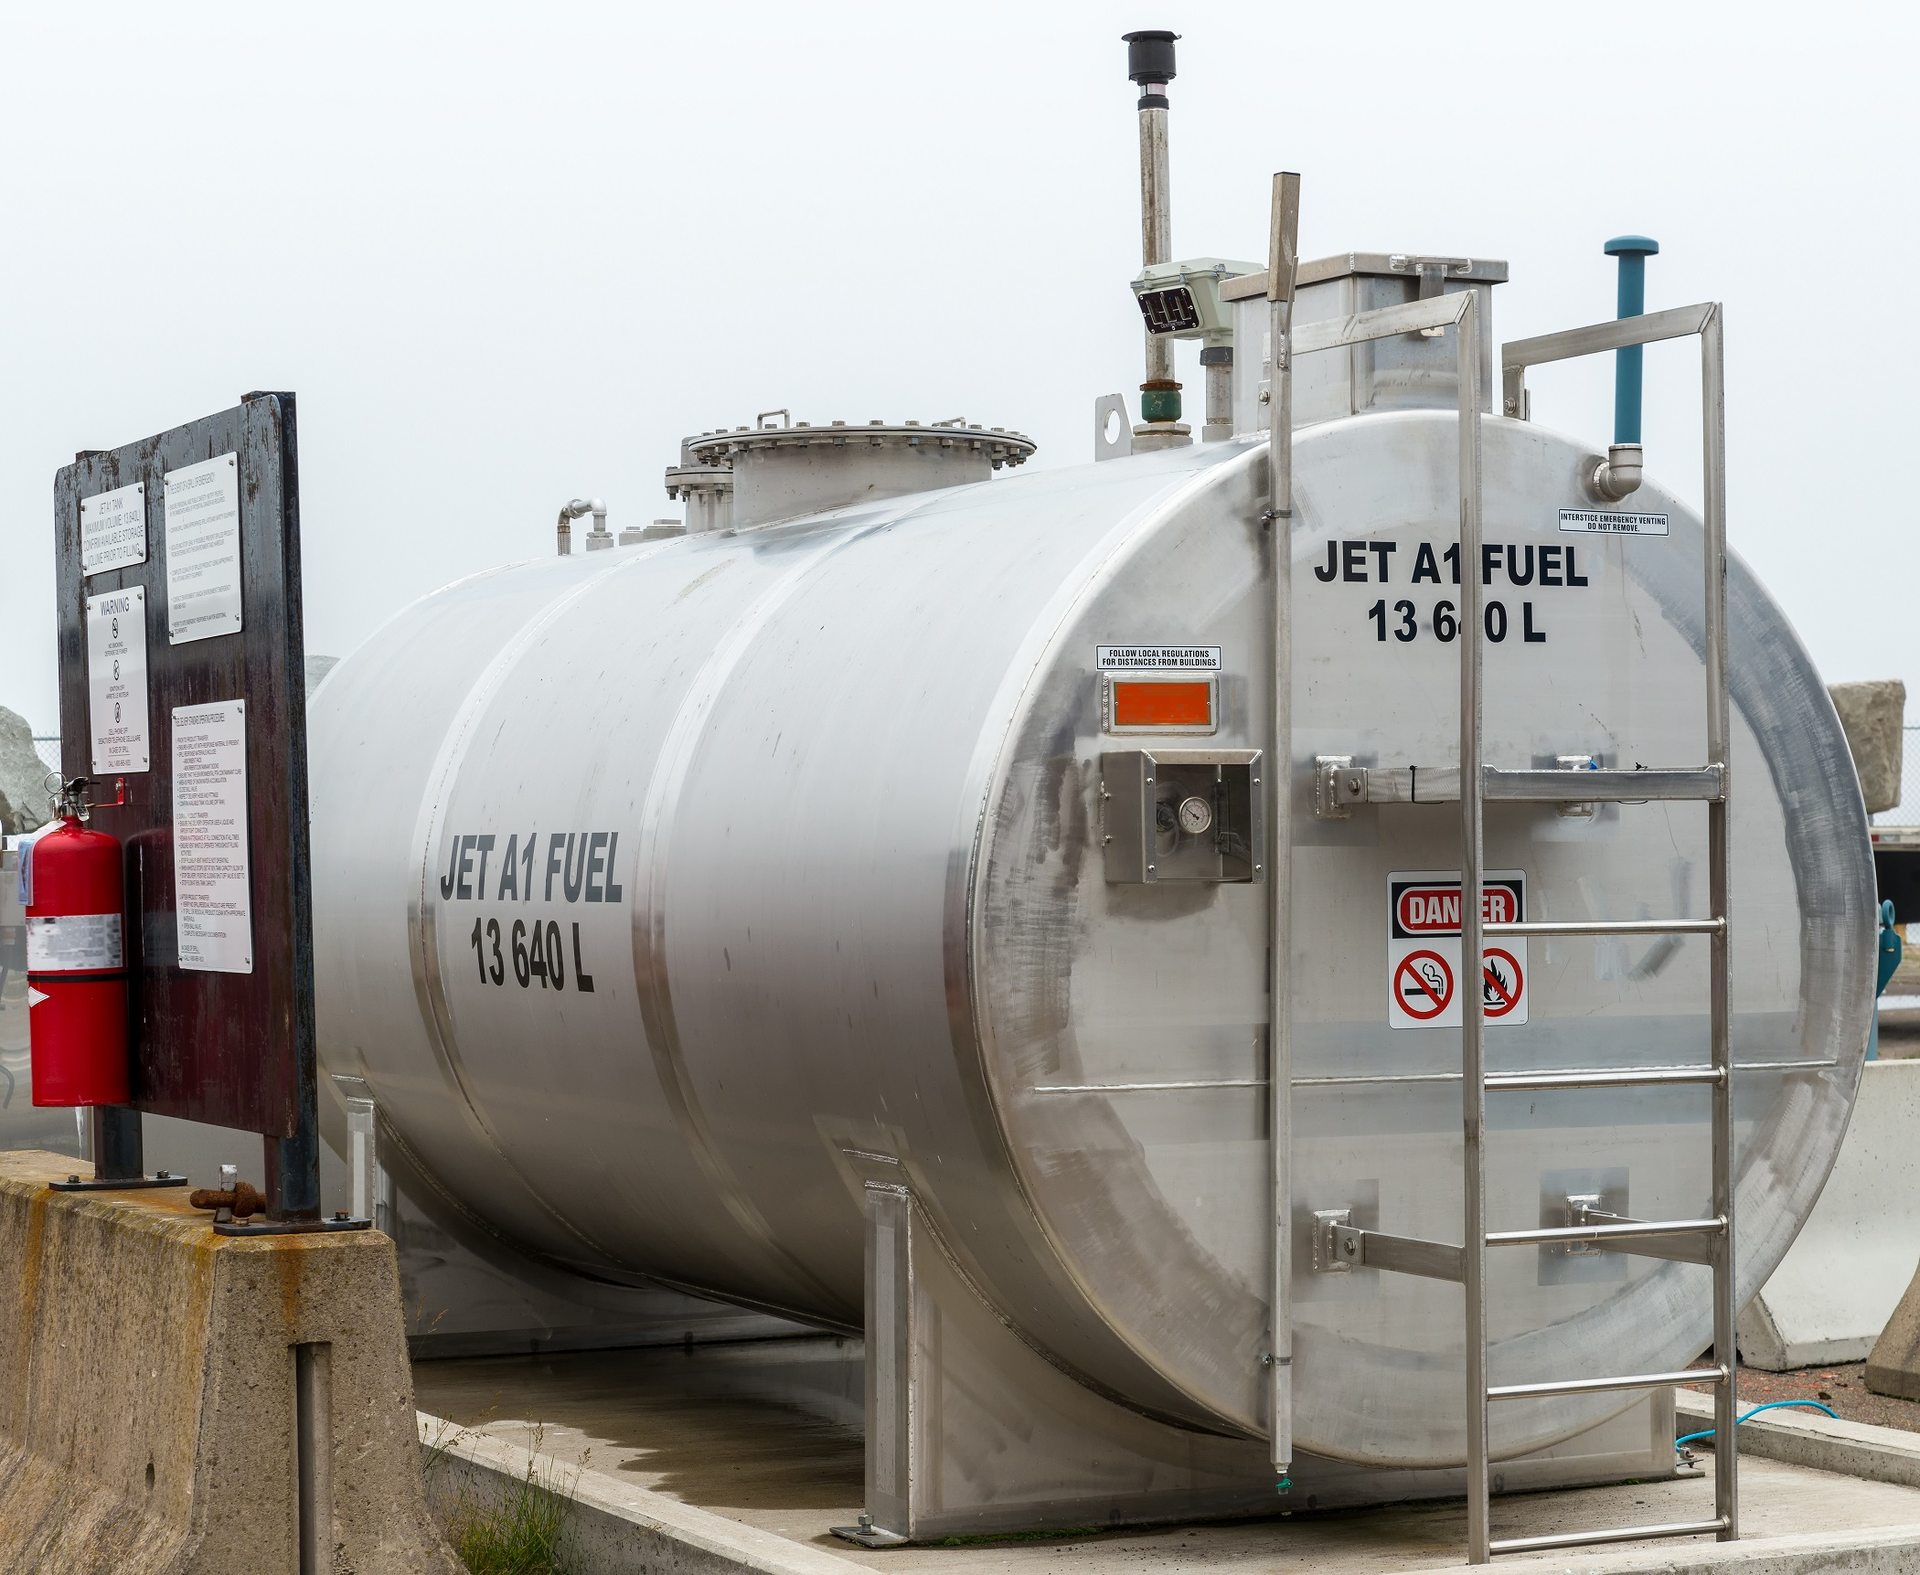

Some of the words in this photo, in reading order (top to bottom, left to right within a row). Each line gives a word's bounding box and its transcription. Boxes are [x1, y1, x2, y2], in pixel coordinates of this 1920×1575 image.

[112, 497, 124, 511] TANK
[1561, 513, 1598, 521] INTERSTICE
[1600, 515, 1637, 523] EMERGENCY
[1639, 517, 1666, 525] VENTING
[1613, 524, 1640, 532] REMOVE.
[84, 537, 101, 552] CONFIRM
[102, 531, 122, 547] AVAILABLE
[123, 525, 143, 542] STORAGE
[88, 552, 103, 567] VOLUME
[104, 549, 116, 563] PRIOR
[1314, 540, 1397, 582] JET
[1411, 542, 1460, 584] A1
[1482, 544, 1588, 586] FUEL
[100, 597, 130, 616] WARNING
[1368, 599, 1418, 642] 13
[1433, 600, 1508, 643] 60
[1523, 602, 1546, 642] L
[1109, 649, 1136, 657] FOLLOW
[1163, 650, 1210, 658] REGULATIONS
[440, 834, 496, 900] JET
[498, 832, 537, 901] A1
[544, 831, 623, 903] FUEL
[1409, 896, 1506, 924] DANER
[471, 917, 505, 986] 13
[511, 919, 564, 992] 640
[572, 922, 595, 993] L
